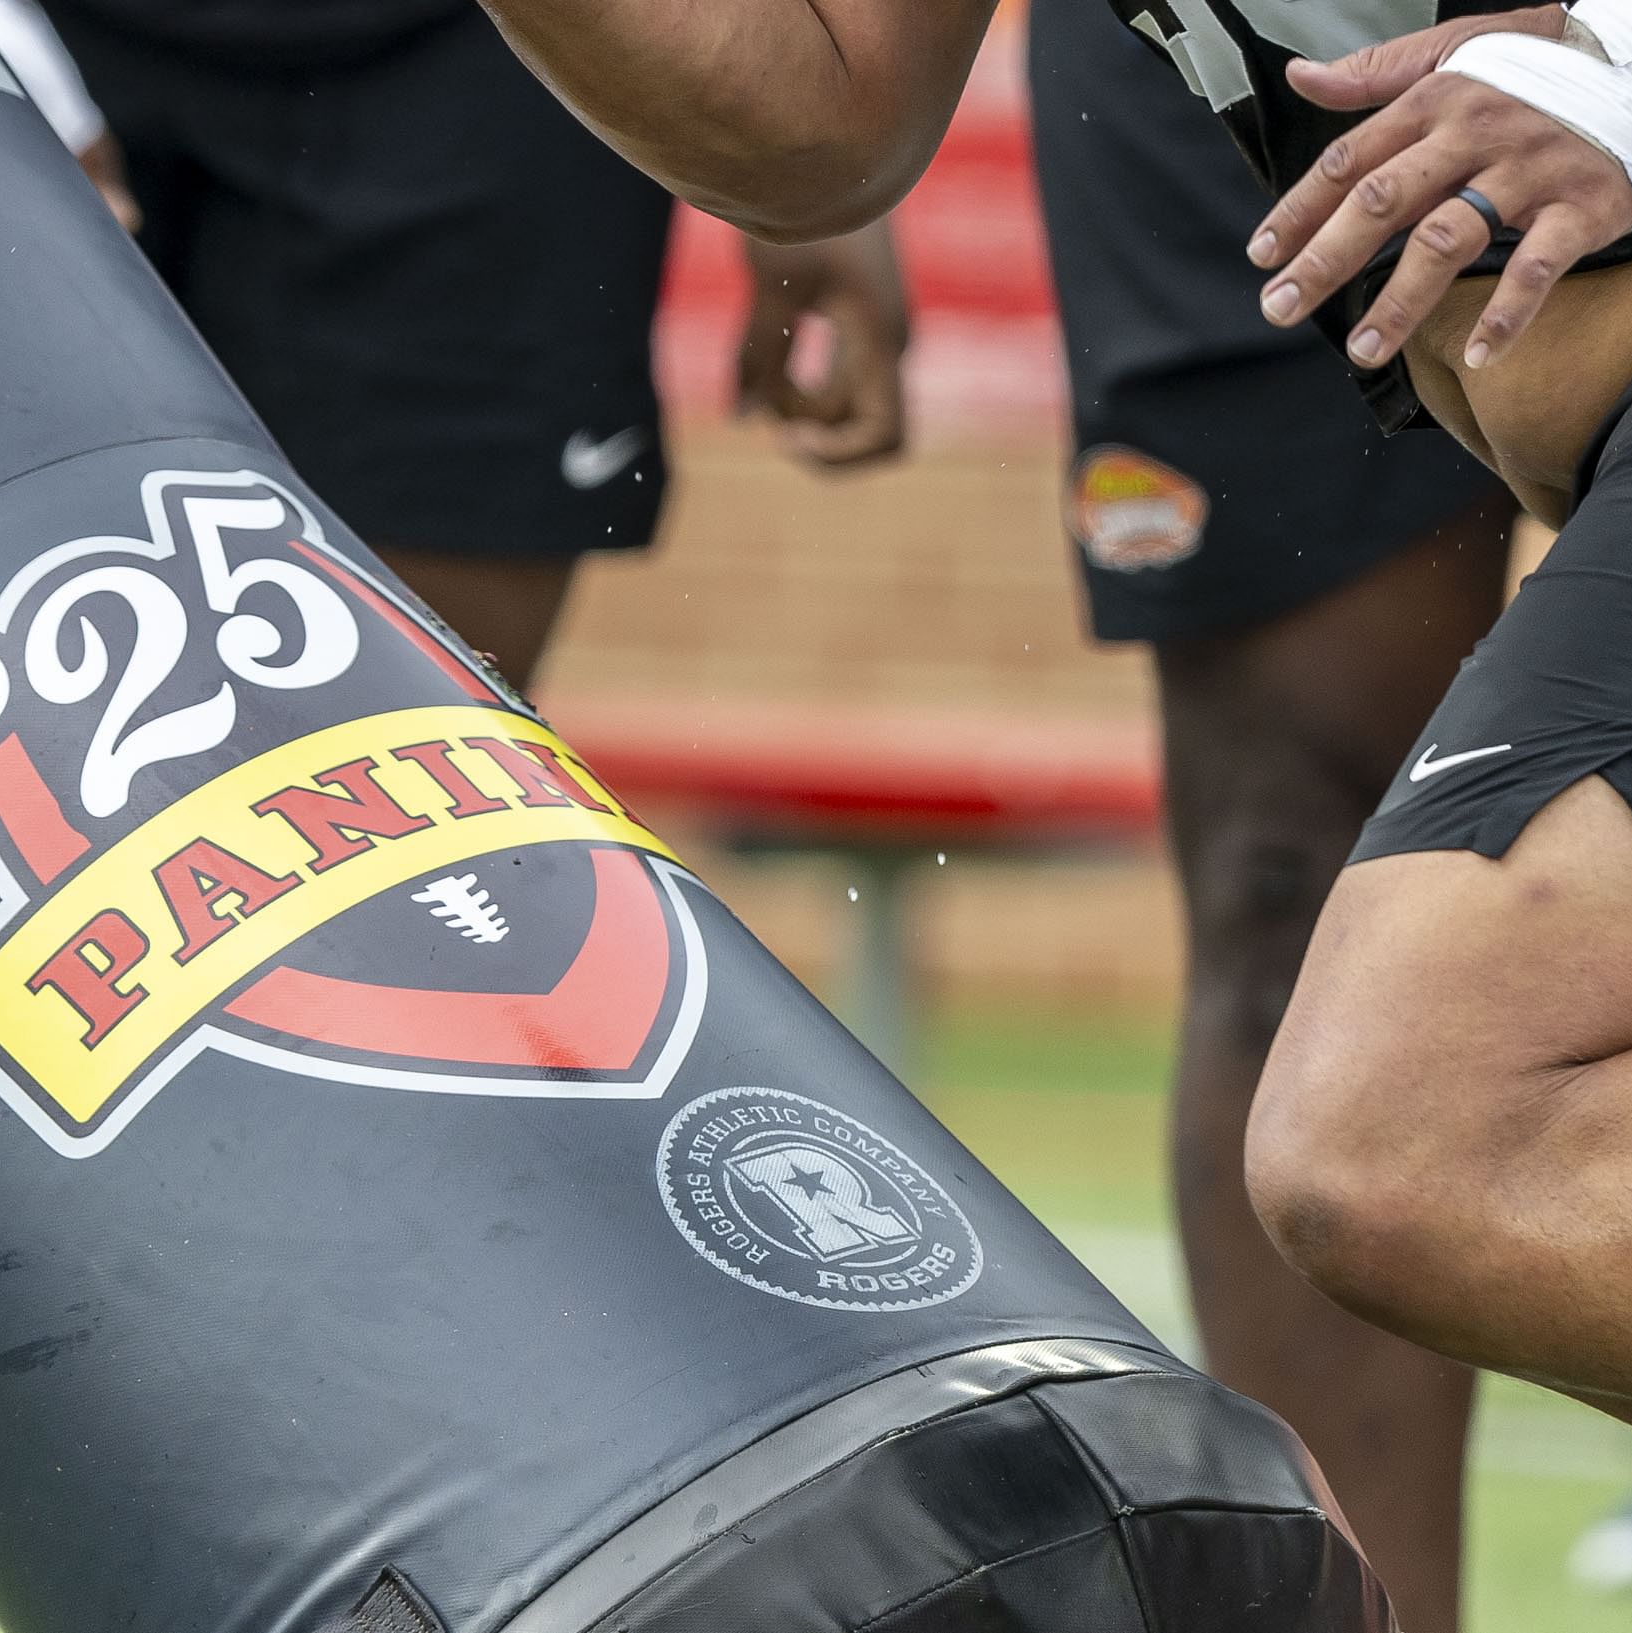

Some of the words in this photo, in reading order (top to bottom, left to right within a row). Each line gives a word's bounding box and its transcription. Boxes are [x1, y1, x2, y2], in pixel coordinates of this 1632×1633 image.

[687, 1104, 802, 1168] ATHLETIC
[813, 1115, 947, 1220] COMPANY
[687, 1172, 772, 1266] ROGERS
[816, 1241, 957, 1294] ROGERS
